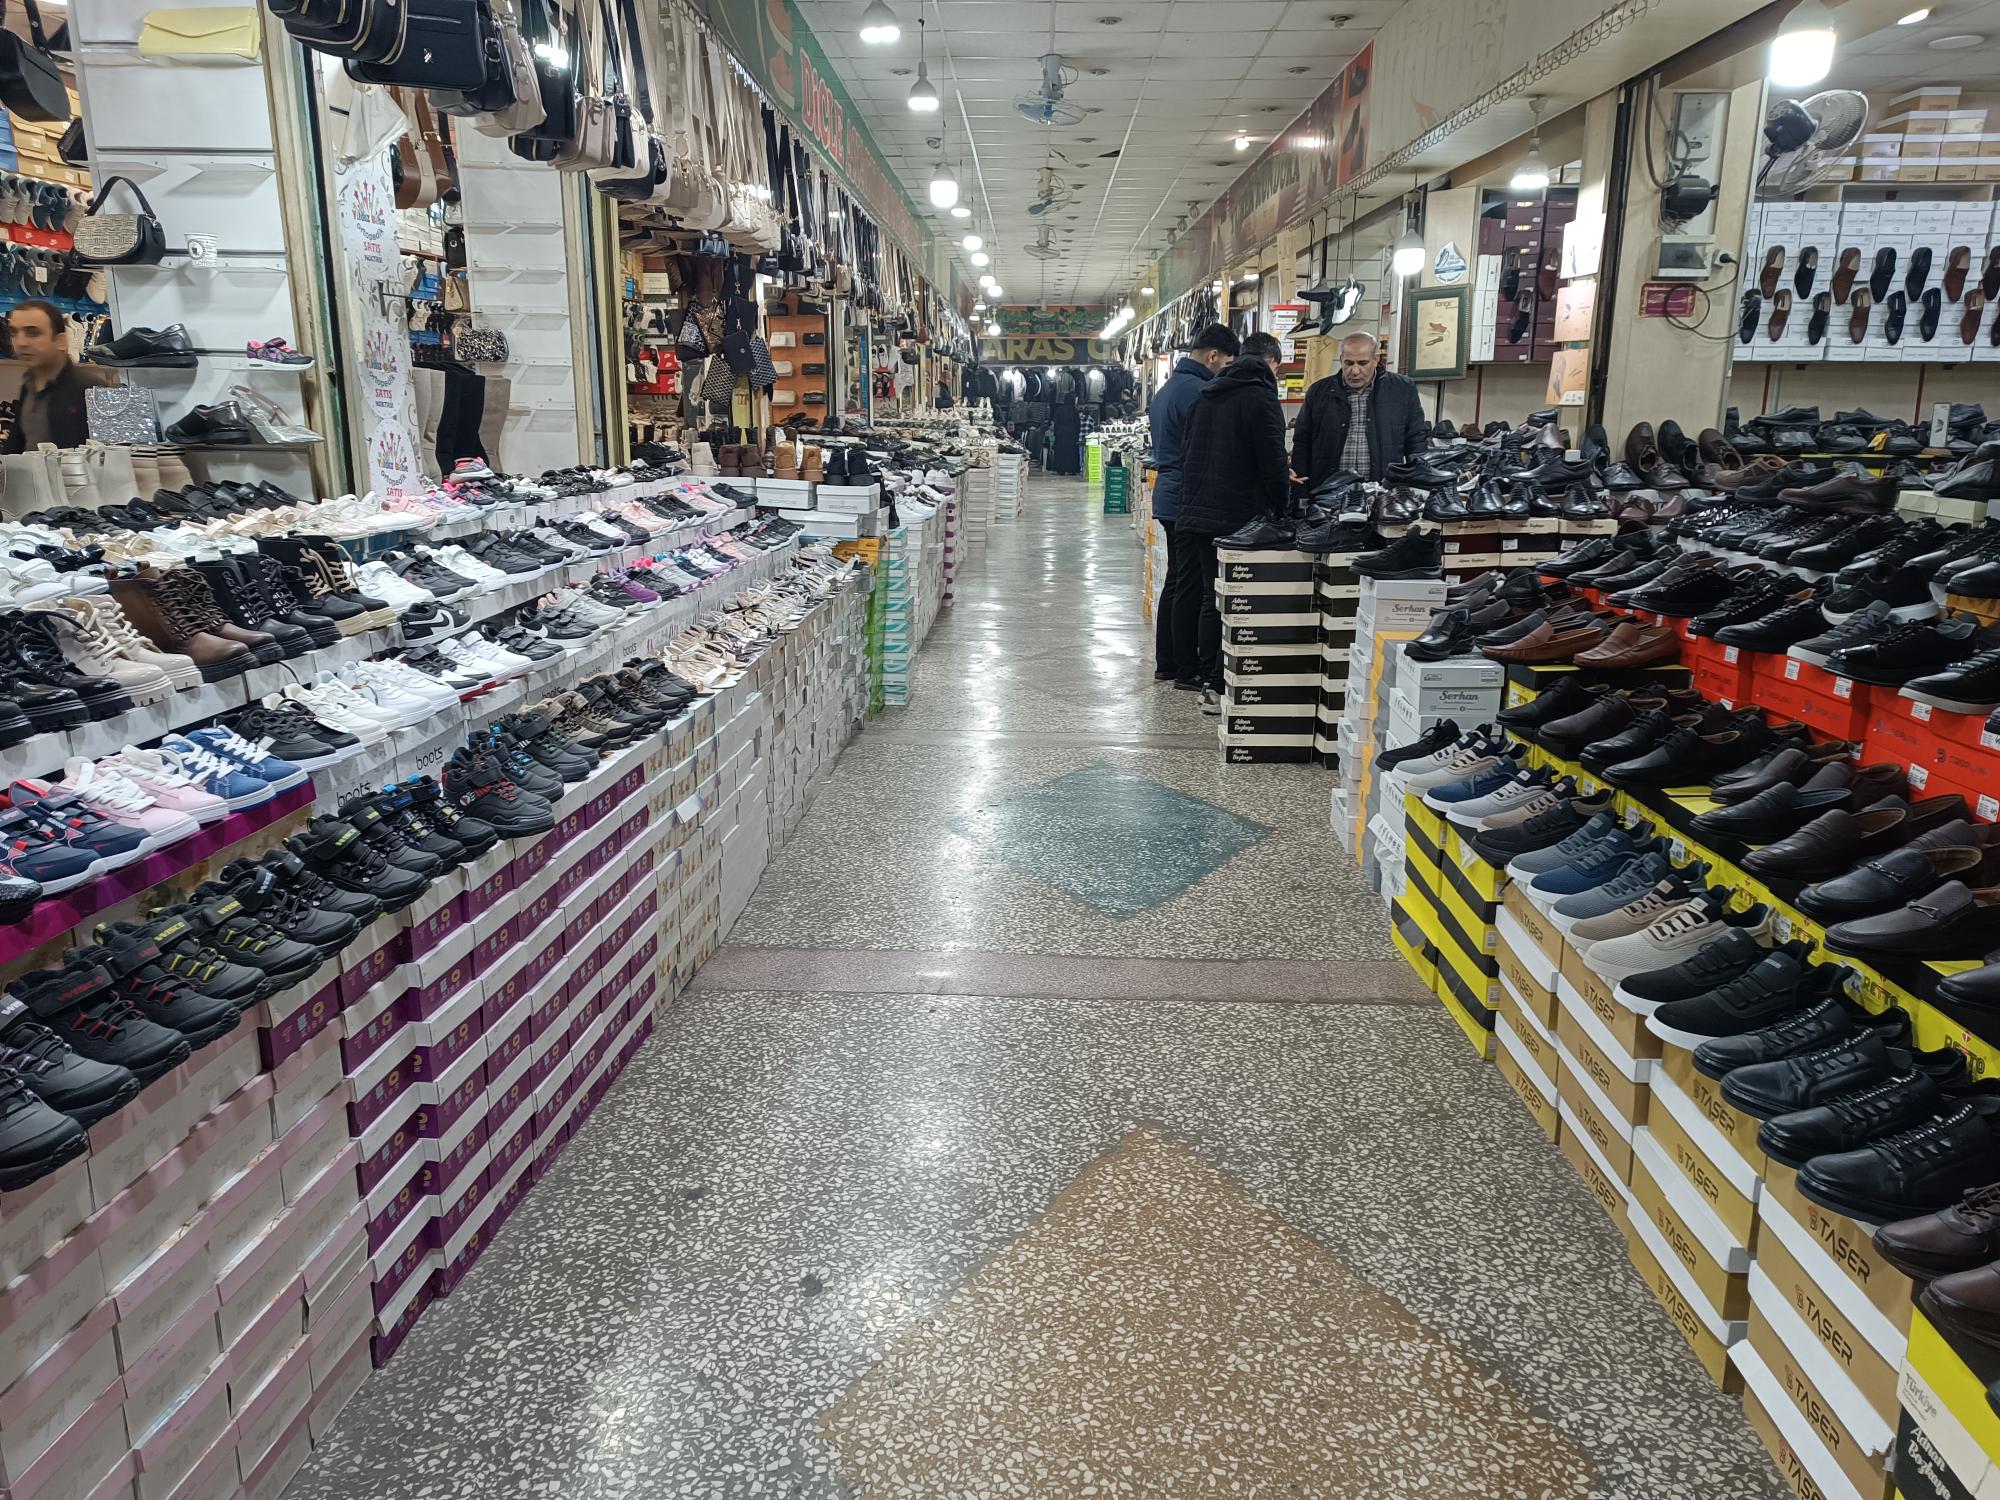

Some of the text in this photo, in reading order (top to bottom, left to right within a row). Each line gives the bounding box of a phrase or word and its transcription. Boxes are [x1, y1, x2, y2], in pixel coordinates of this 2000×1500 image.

[981, 338, 1076, 361] ARAS
[1392, 604, 1426, 613] Serhan
[1439, 691, 1479, 701] Serhan
[416, 746, 443, 770] boots
[1863, 975, 1898, 1007] RETTO
[1820, 1217, 1871, 1284] TAŞER
[1665, 1284, 1699, 1340] TAŞER
[1806, 1296, 1853, 1367] TAŞER
[1794, 1377, 1840, 1451] TAŞER
[1905, 1373, 1938, 1417] Türkiye
[1908, 1439, 1952, 1500] Bozkaya
[1910, 1427, 1946, 1473] Adnan
